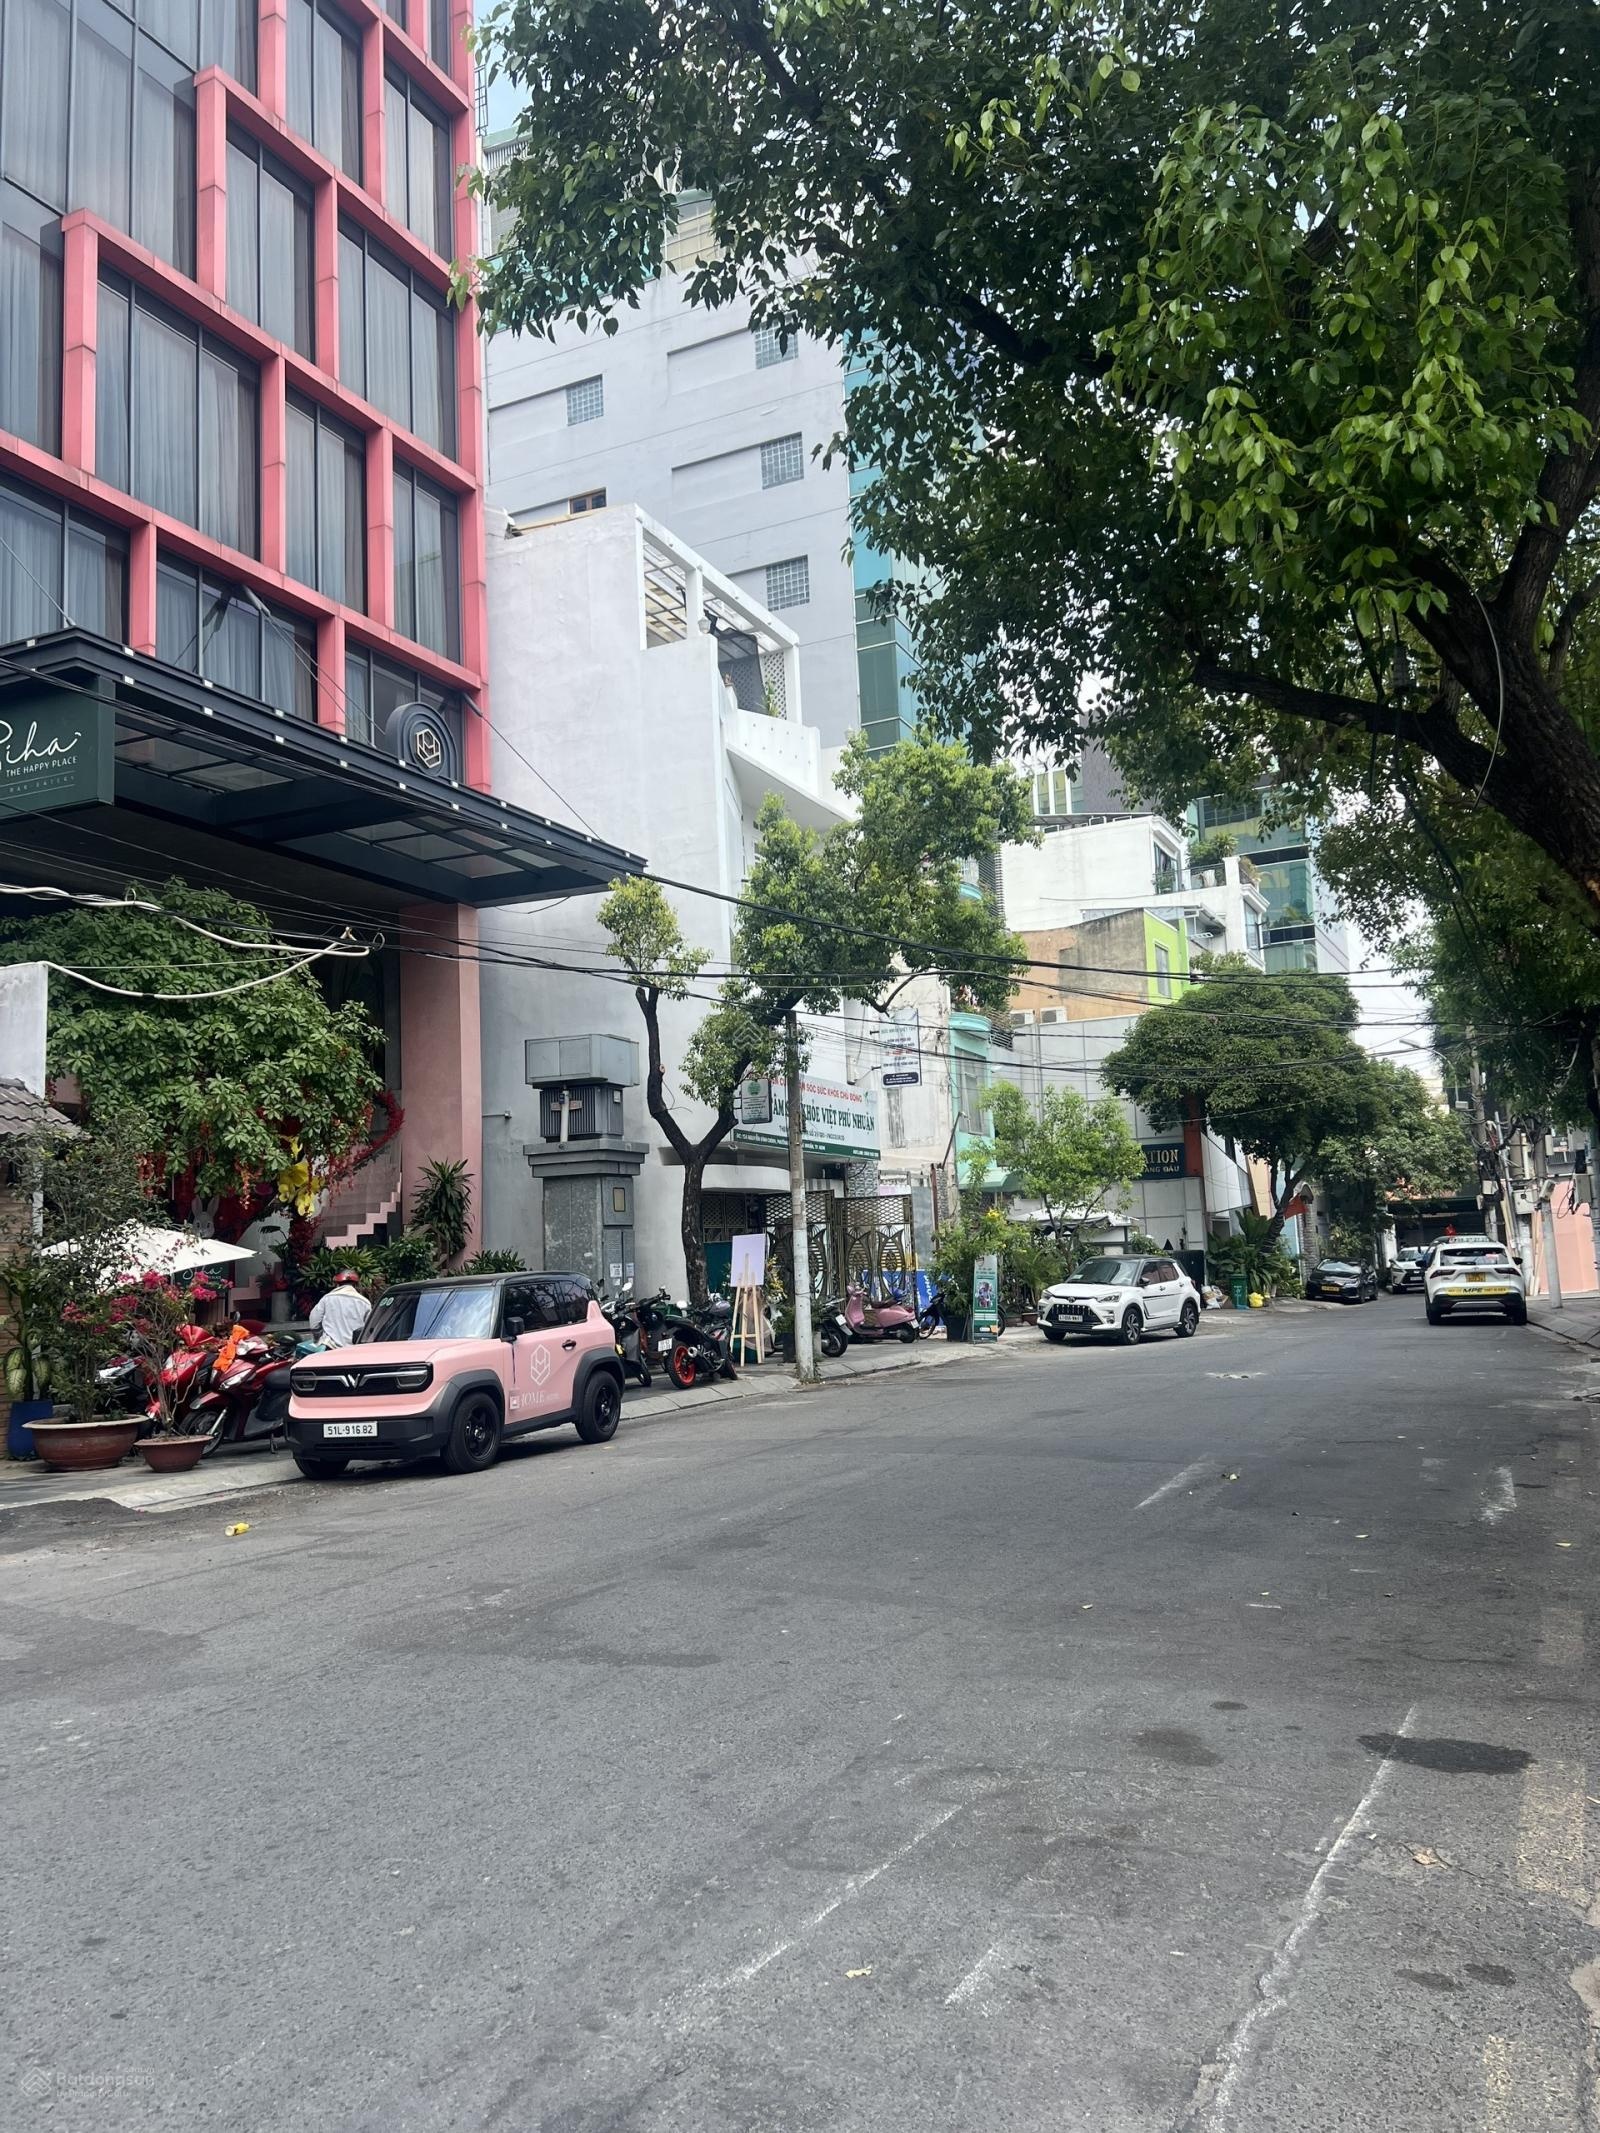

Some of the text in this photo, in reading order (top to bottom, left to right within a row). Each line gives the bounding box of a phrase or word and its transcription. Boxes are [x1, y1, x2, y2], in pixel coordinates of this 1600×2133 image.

[6, 755, 78, 777] THE HAPPY PLACE
[821, 1103, 837, 1129] VIỆT
[852, 1111, 875, 1135] NHUẬN
